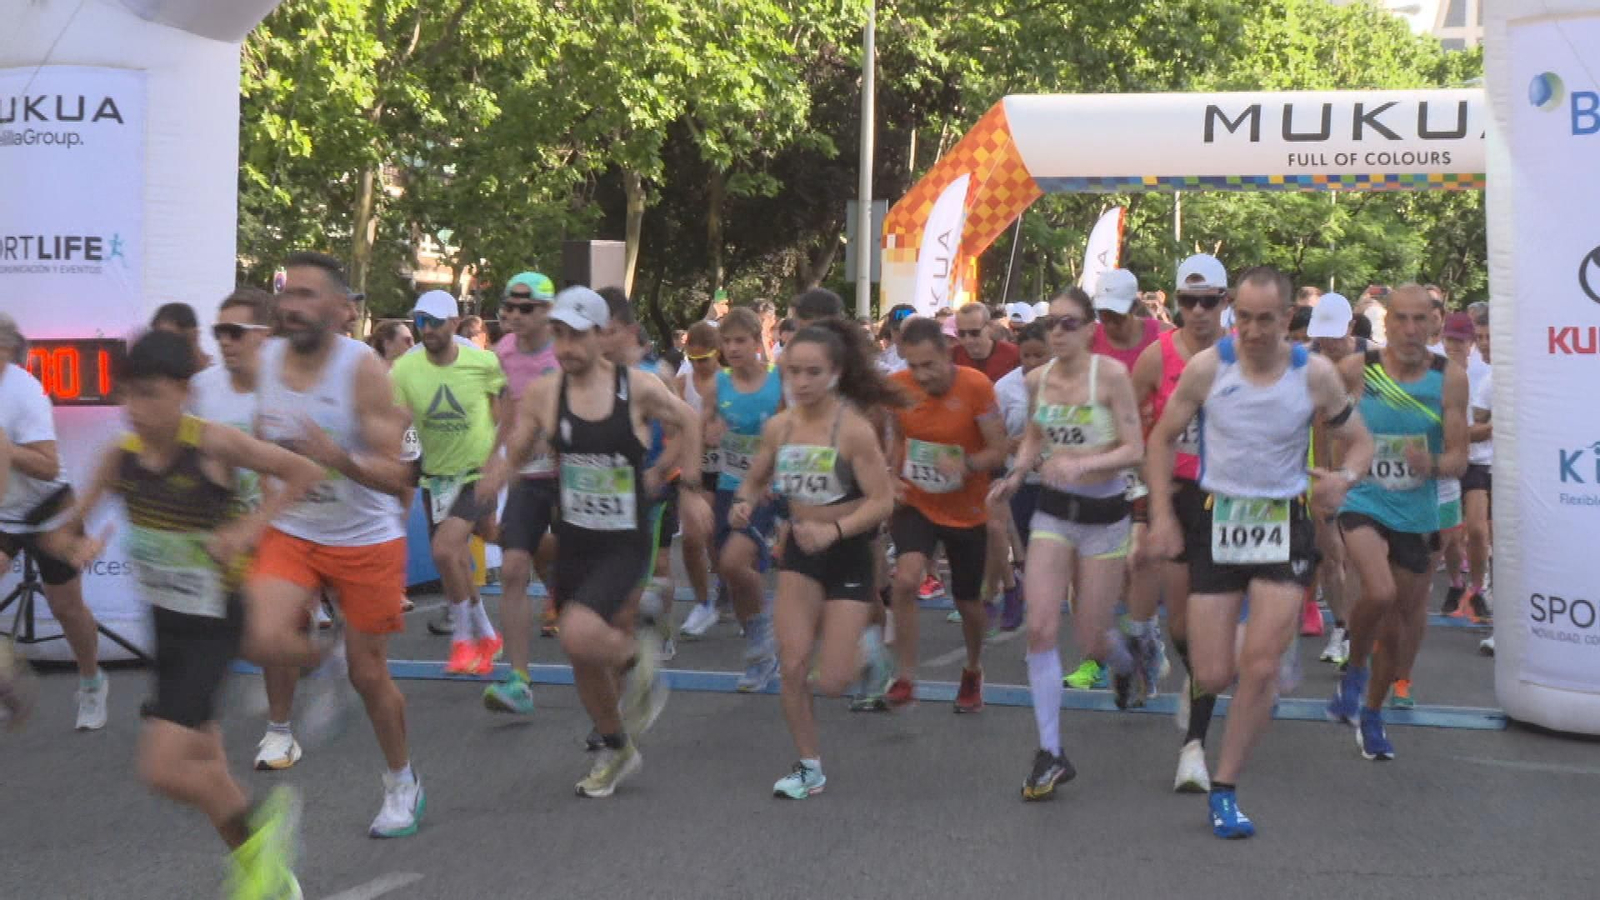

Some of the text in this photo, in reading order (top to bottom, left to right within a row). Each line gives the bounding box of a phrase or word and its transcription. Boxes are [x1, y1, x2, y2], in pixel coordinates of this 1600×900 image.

[1203, 101, 1486, 143] MUKU
[1288, 151, 1451, 167] FULL OF COLOURS
[0, 235, 103, 261] RTLIFE
[1218, 526, 1284, 548] 1094
